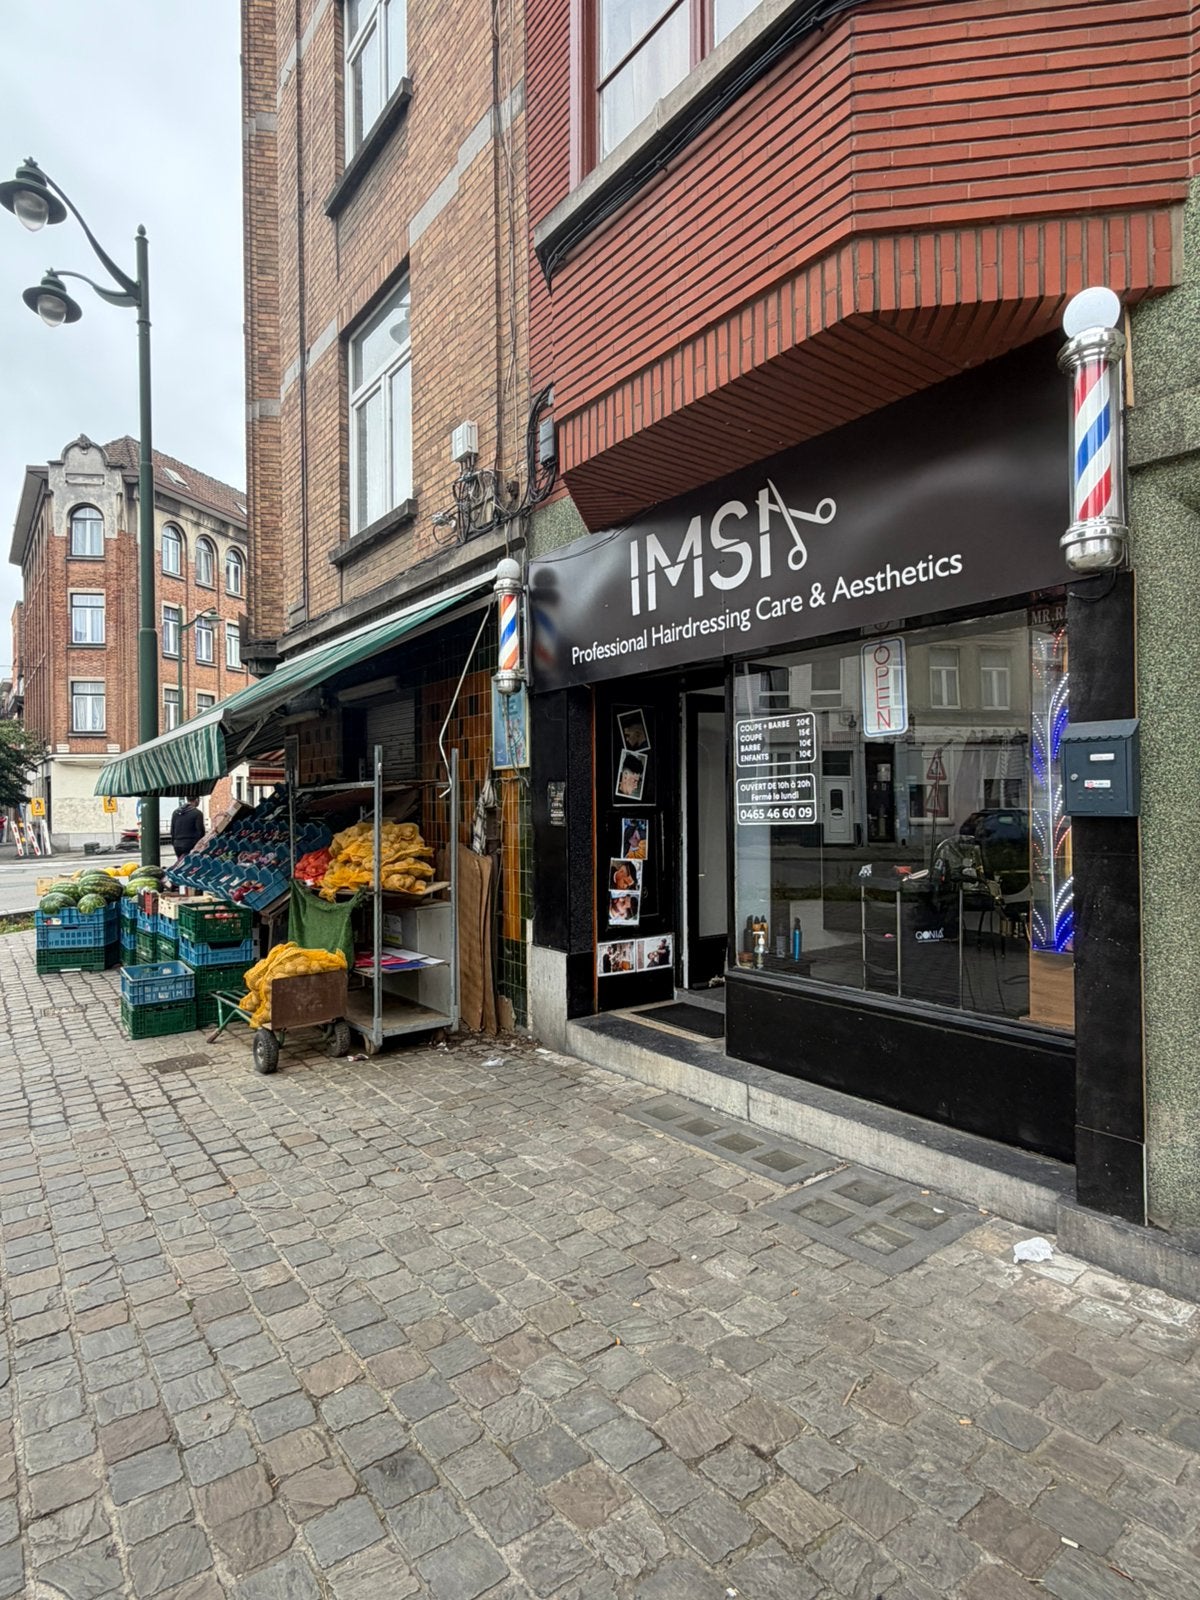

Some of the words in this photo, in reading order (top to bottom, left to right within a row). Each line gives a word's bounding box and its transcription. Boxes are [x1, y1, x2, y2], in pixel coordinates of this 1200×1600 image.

[571, 629, 648, 665] Professional
[651, 608, 751, 647] Hairdressing
[755, 596, 803, 621] Care
[808, 582, 827, 608] &
[831, 554, 963, 603] Aesthetics
[873, 645, 891, 730] OPEN
[740, 723, 762, 732] COUPE
[768, 720, 790, 729] BARBE
[796, 718, 810, 727] 20€
[740, 733, 762, 742] COUPE
[799, 728, 810, 736] 15€
[740, 744, 761, 752] BARBE
[799, 739, 811, 747] 10€
[740, 753, 769, 762] ENFANTS
[740, 783, 766, 792] OUVERT
[767, 782, 776, 790] DE
[778, 781, 789, 789] 10h
[791, 780, 796, 788] à
[797, 779, 811, 787] 20h
[751, 792, 772, 802] Fermé
[781, 791, 799, 799] lundi
[740, 809, 764, 819] 0465
[767, 808, 780, 818] 46
[782, 808, 796, 818] 60
[798, 807, 812, 818] 09
